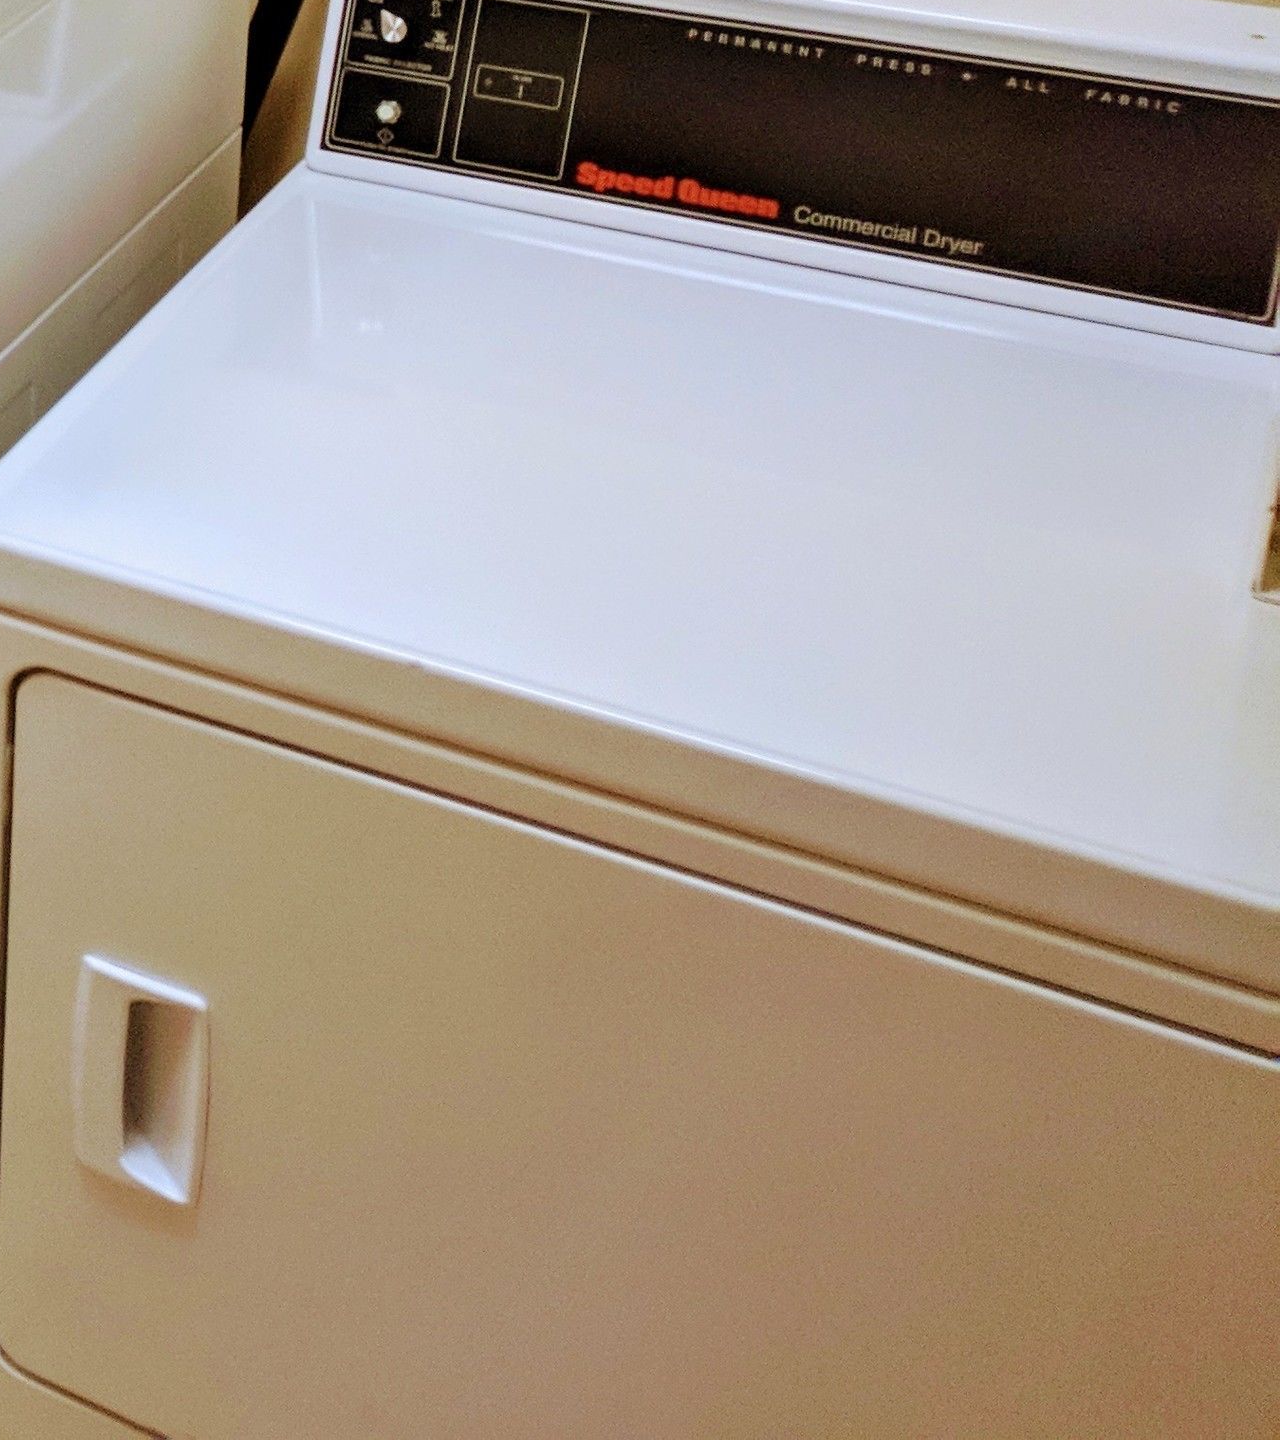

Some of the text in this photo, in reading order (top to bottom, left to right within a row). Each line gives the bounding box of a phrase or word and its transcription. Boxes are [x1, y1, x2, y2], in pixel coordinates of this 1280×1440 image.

[687, 27, 1183, 114] PERMANENT PRESS ALL FABRIC
[575, 161, 984, 257] Speed Queen Commercial Dryer
